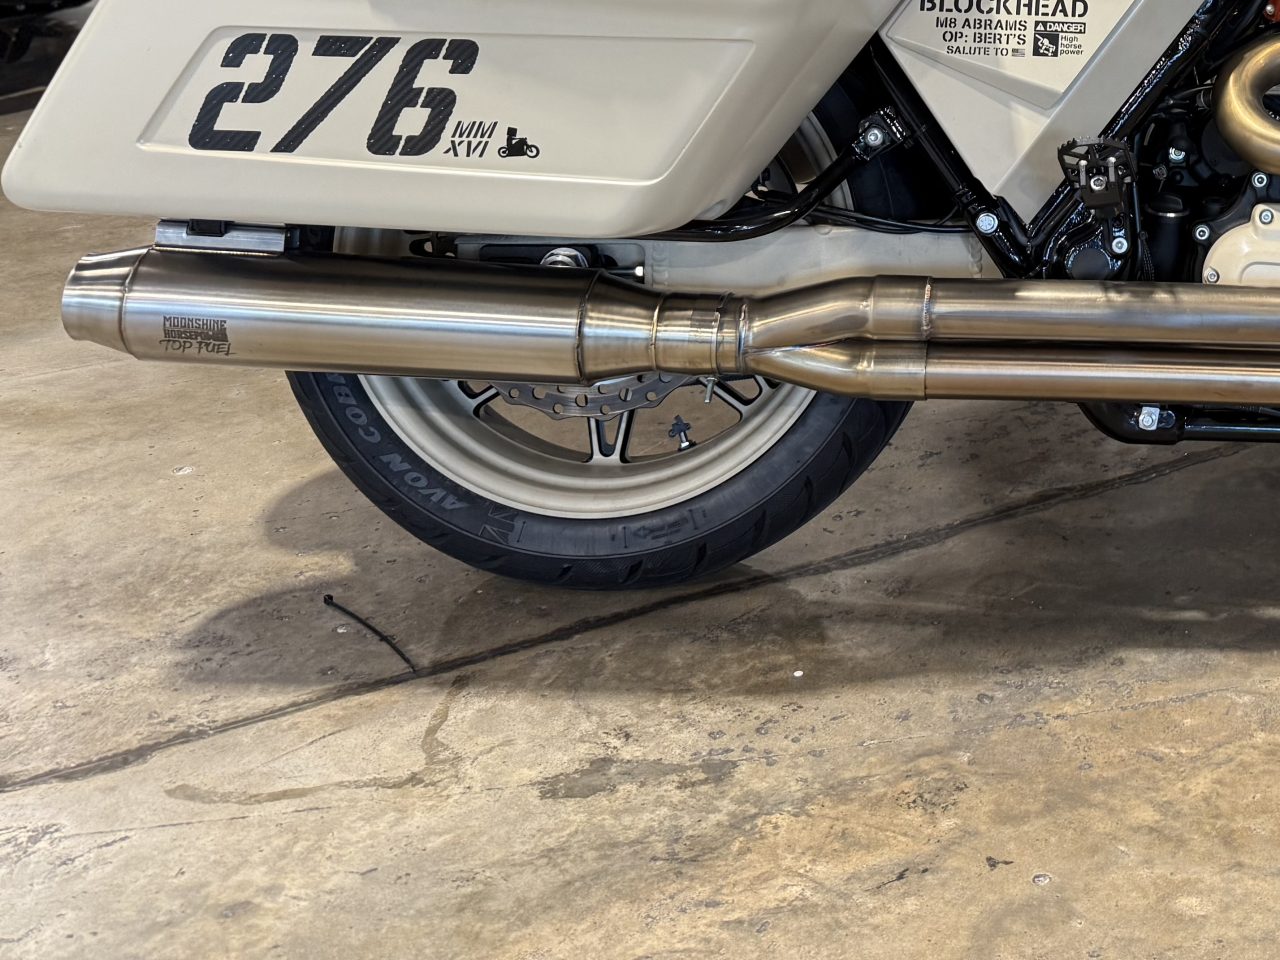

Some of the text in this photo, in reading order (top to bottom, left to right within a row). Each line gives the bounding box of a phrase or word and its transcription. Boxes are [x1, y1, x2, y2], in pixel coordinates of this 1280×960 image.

[935, 17, 1027, 31] M8 ABRAMS
[1046, 22, 1085, 32] DANGER
[942, 31, 1026, 45] OP: BERT'S
[1061, 35, 1078, 43] High
[947, 46, 1008, 56] SALUTE TO
[1060, 48, 1084, 56] power
[189, 33, 479, 156] 276
[451, 121, 498, 139] MM
[443, 140, 490, 157] XVI
[163, 316, 227, 331] MOONSHINE
[159, 339, 237, 356] TOP FUEL
[379, 453, 471, 510] AVON
